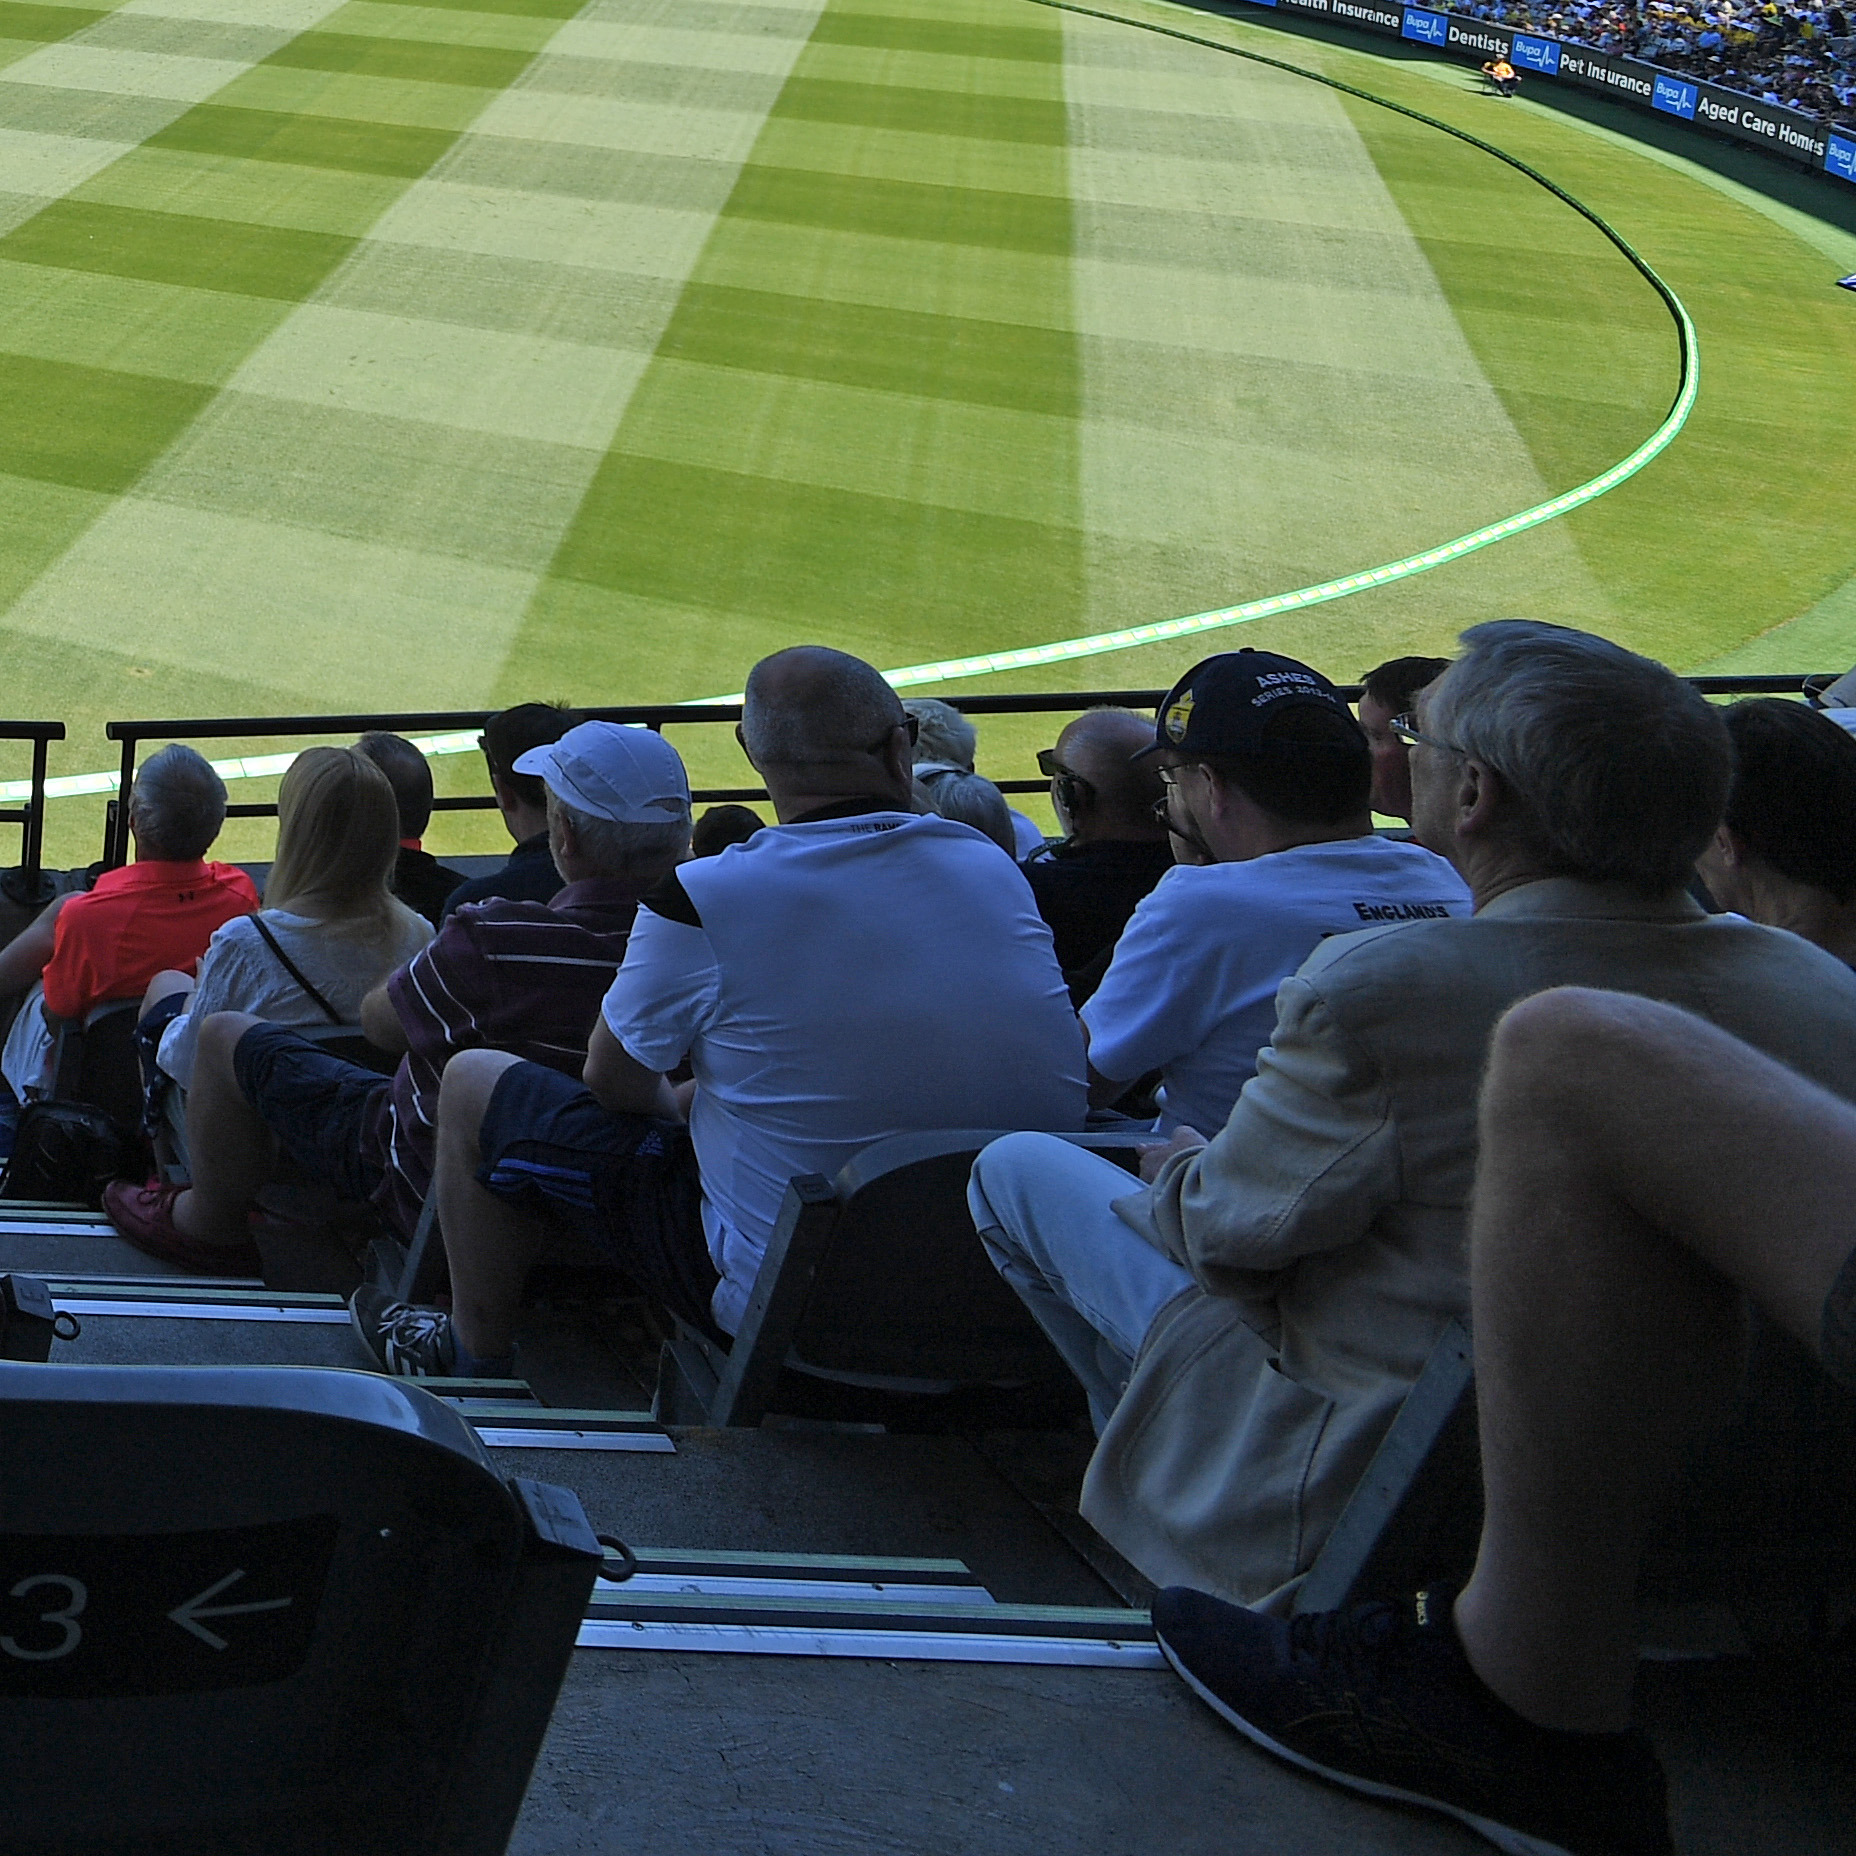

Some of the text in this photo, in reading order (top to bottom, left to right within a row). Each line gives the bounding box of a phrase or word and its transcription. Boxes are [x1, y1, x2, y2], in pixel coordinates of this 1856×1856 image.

[1406, 15, 1430, 30] Bupa
[1449, 25, 1509, 55] Dentists
[1515, 40, 1541, 56] Bupa
[1559, 54, 1584, 75] Pet
[1587, 61, 1652, 96] Insurance
[1656, 82, 1679, 99] Bupa
[1698, 98, 1738, 125] Aged
[1741, 111, 1775, 137] Care
[1779, 124, 1824, 157] Homes
[1829, 142, 1852, 162] Bupa
[1256, 672, 1317, 689] ASHES
[1251, 686, 1293, 708] SERIES
[850, 824, 872, 833] THE
